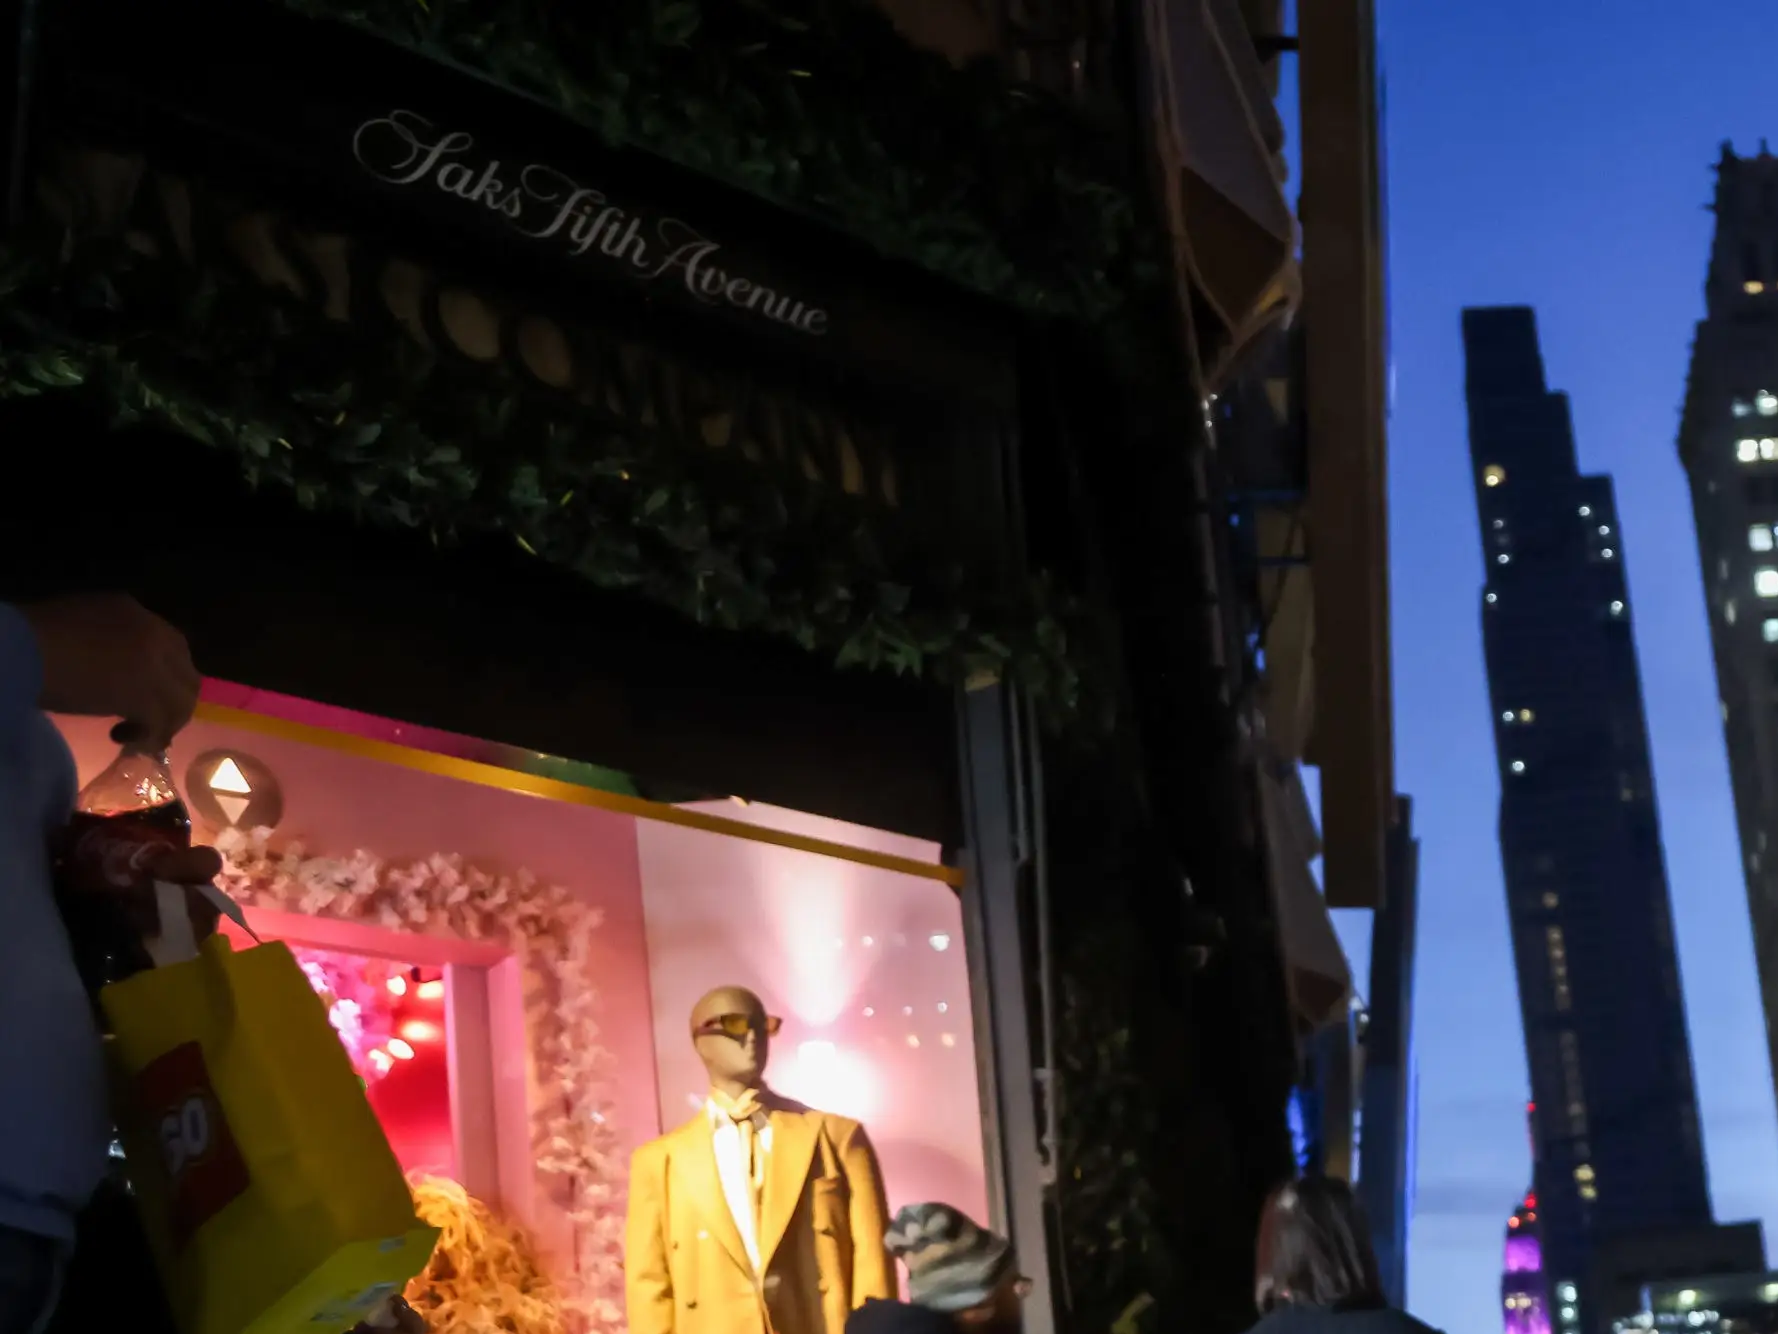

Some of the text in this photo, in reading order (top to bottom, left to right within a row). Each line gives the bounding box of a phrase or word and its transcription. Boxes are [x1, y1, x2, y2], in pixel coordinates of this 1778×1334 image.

[352, 108, 829, 335] Saks Fifth Avenue
